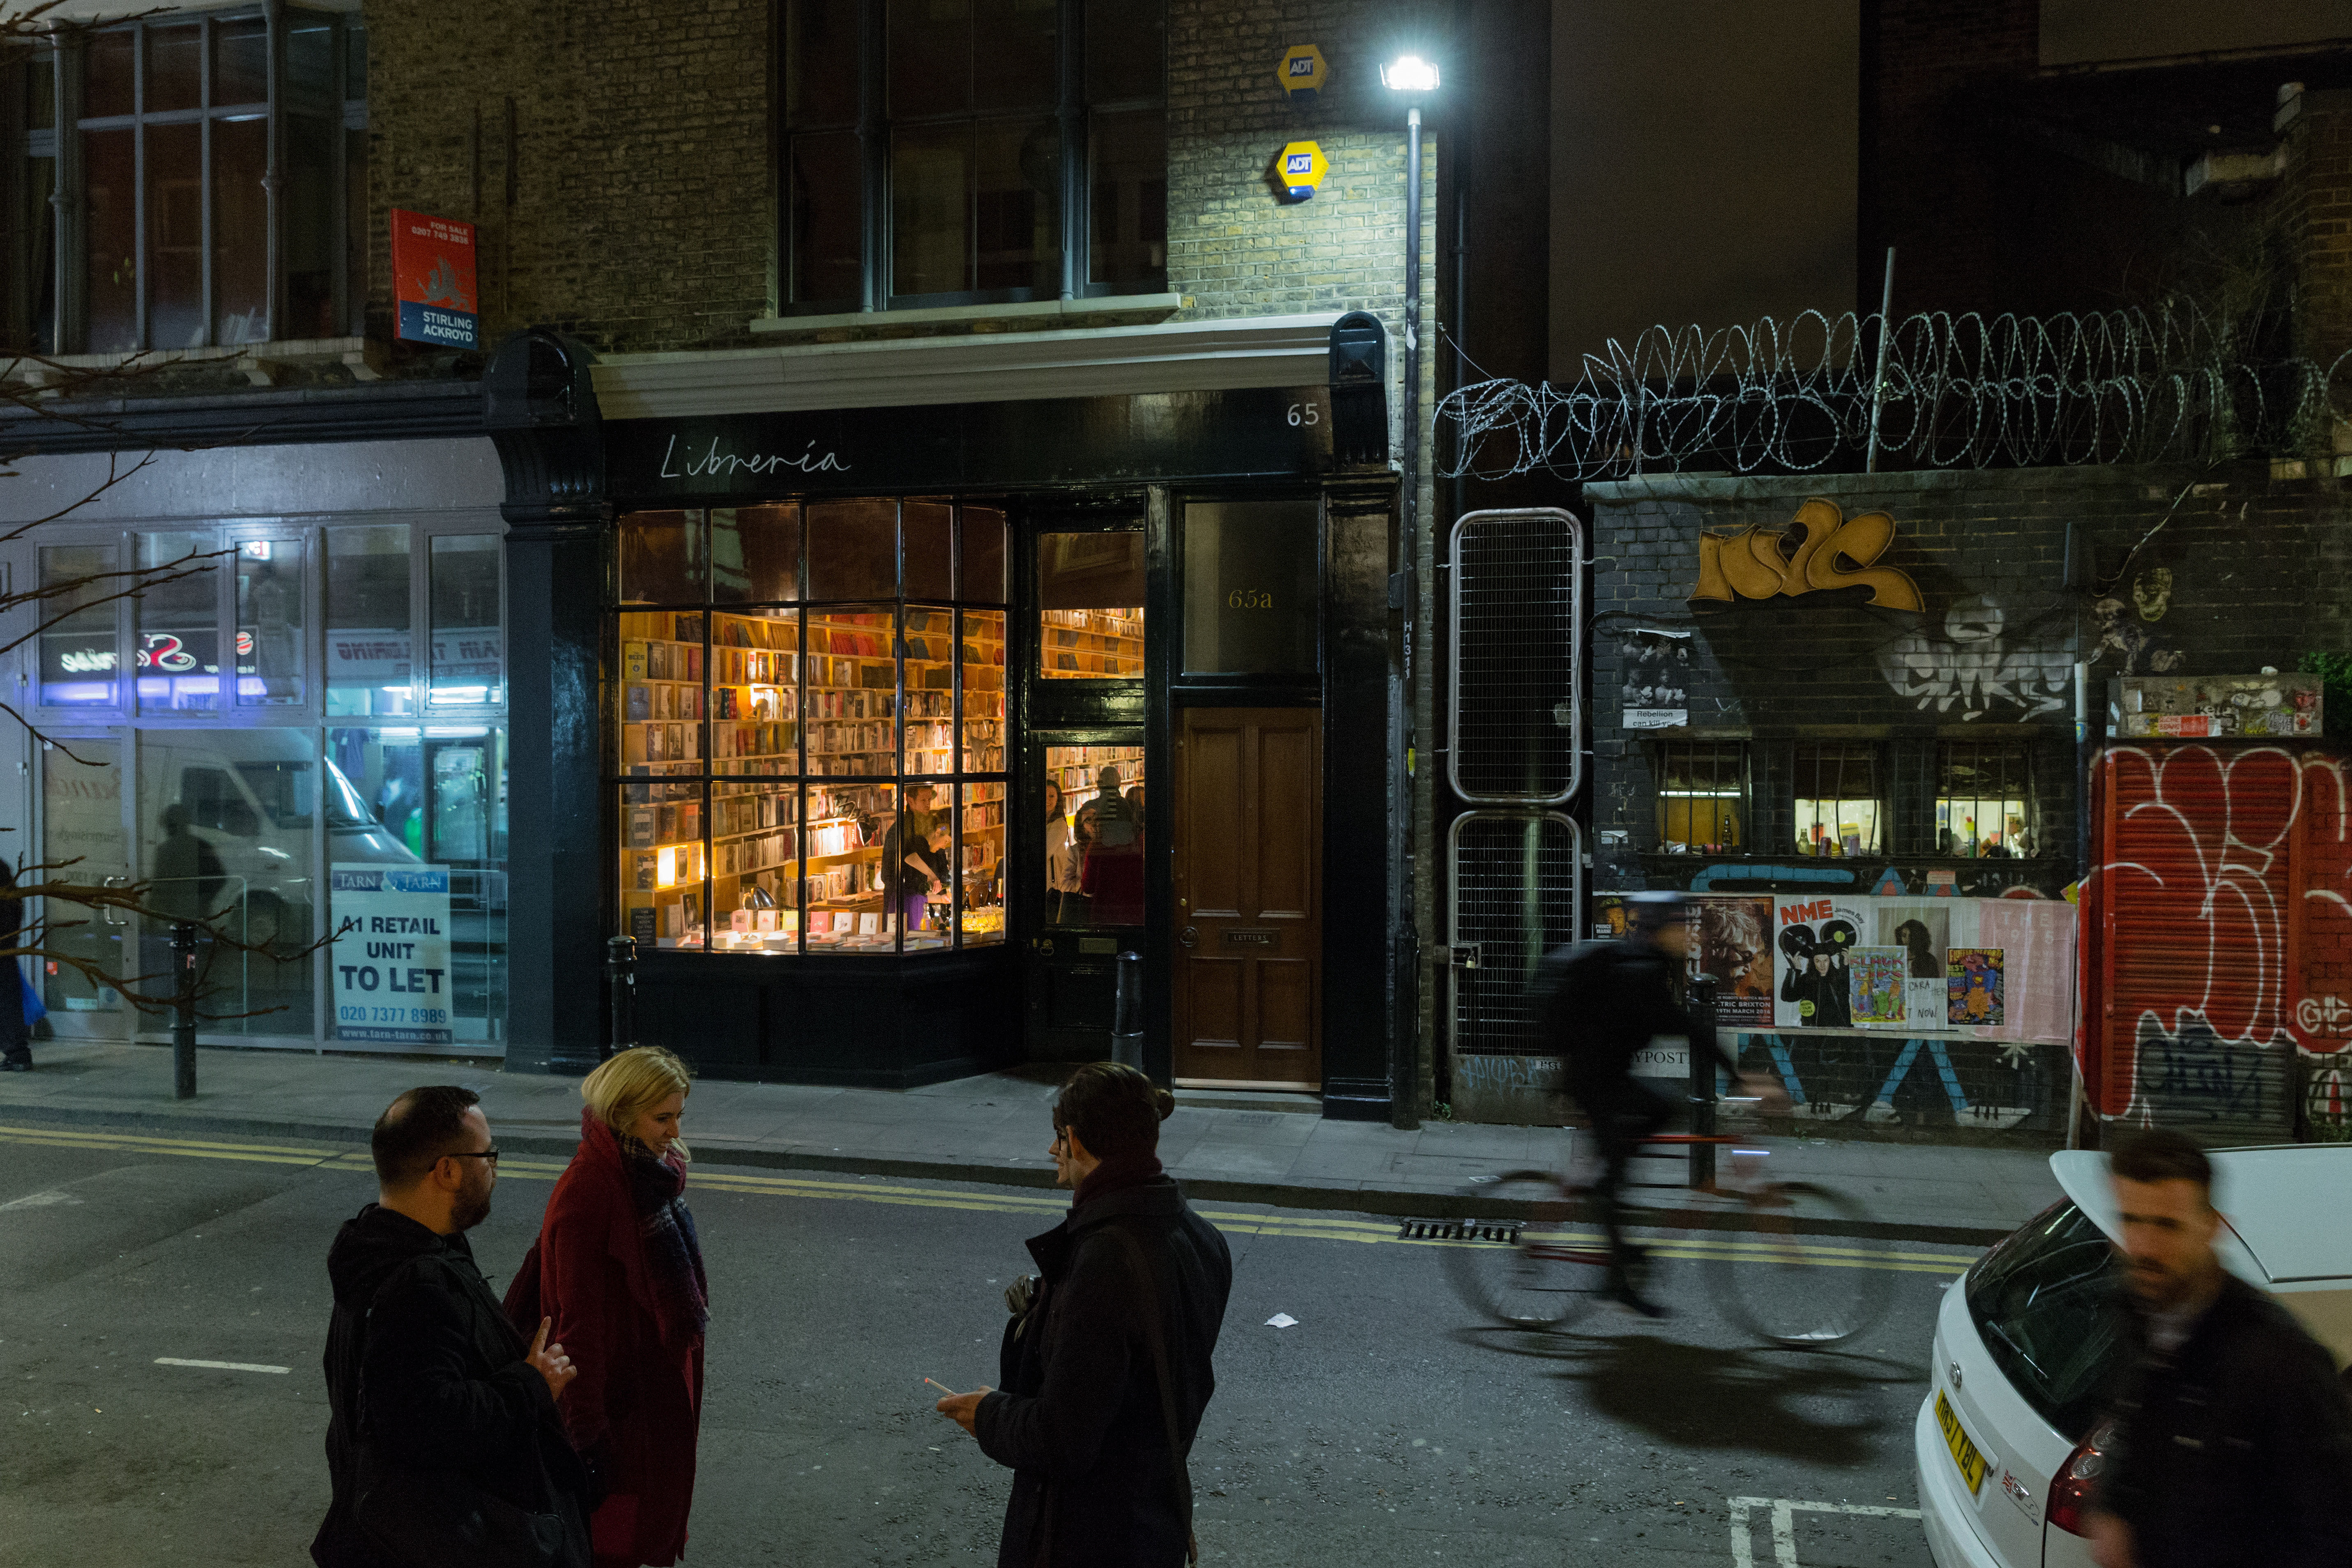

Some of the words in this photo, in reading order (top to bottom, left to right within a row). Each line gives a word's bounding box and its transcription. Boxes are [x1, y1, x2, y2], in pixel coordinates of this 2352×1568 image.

[1290, 59, 1313, 74] ADT
[1287, 156, 1311, 171] ADT
[430, 221, 446, 231] FOR
[449, 226, 468, 236] SALE
[423, 311, 472, 329] STIRLING
[423, 325, 473, 342] ACKROYD
[1287, 403, 1319, 426] 65
[1229, 589, 1273, 608] 65a
[338, 874, 375, 887] TARN
[404, 875, 441, 889] TARN
[1780, 899, 1833, 925] NME
[1834, 907, 1855, 916] James
[1855, 913, 1865, 924] Bay
[2001, 912, 2049, 927] THE
[341, 916, 362, 933] A1
[371, 916, 440, 935] RETAIL
[367, 942, 415, 959] UNIT
[339, 965, 380, 991] TO
[389, 967, 444, 993] LET
[1909, 980, 1930, 991] CARA
[341, 1006, 366, 1021] 020
[371, 1007, 405, 1022] 7377
[411, 1008, 447, 1023] 8989
[1918, 1005, 1938, 1018] NOW
[1629, 1051, 1689, 1064] YPOST
